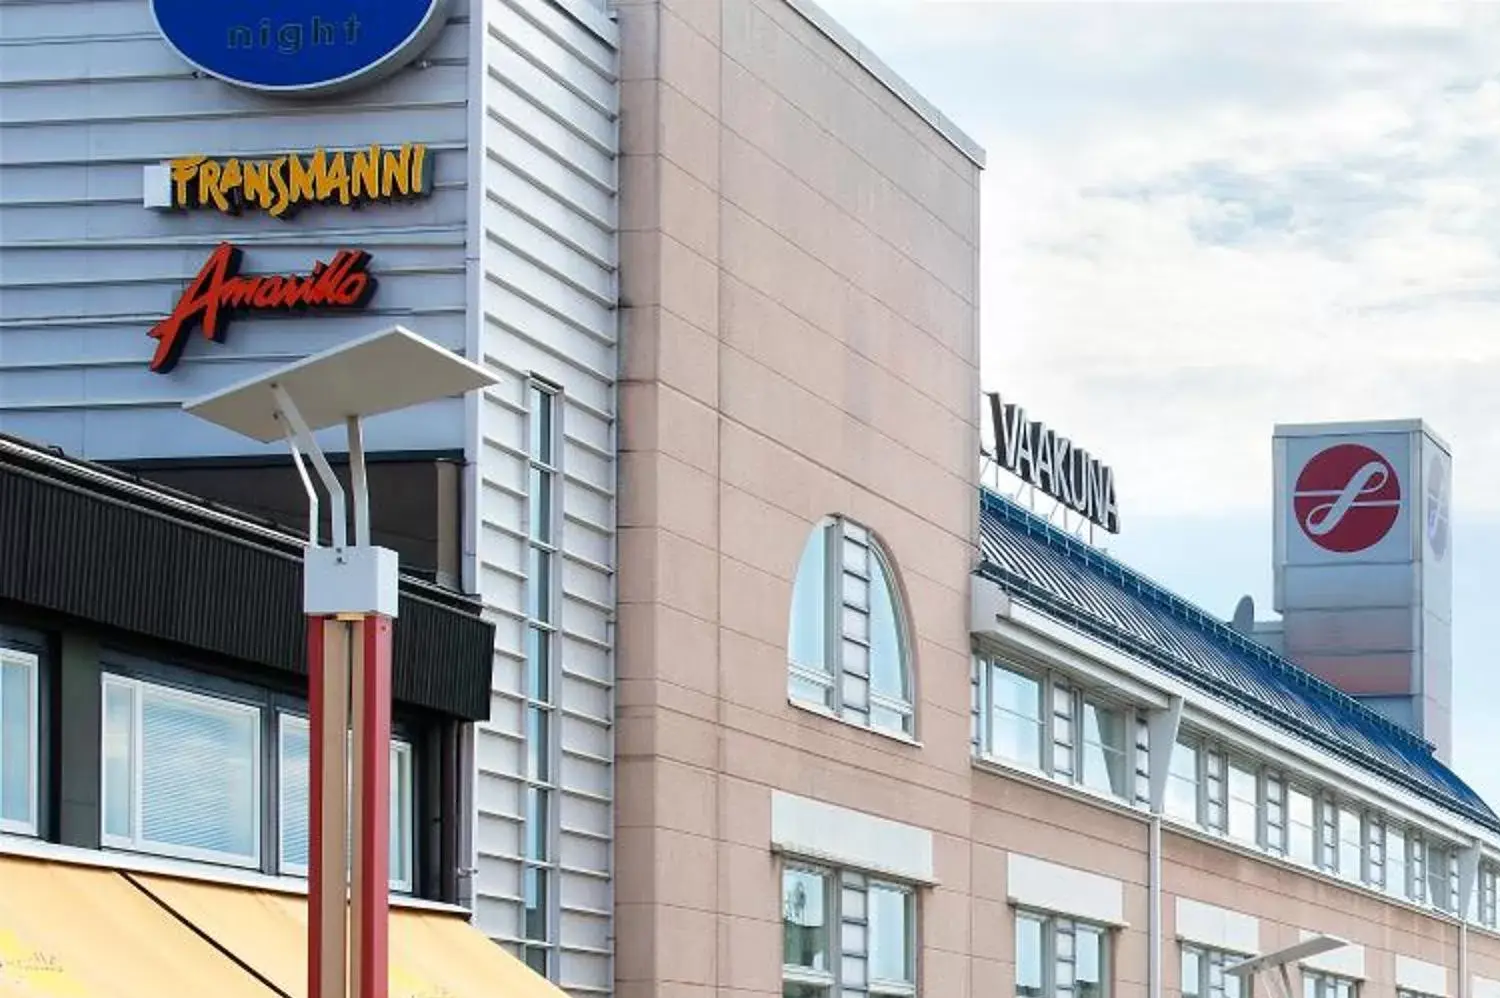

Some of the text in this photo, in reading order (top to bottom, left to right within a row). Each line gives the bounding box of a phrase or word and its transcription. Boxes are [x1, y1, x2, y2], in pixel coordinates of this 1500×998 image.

[226, 15, 362, 54] night
[146, 242, 370, 373] Amarillo
[988, 391, 1119, 534] VAAKUNA
